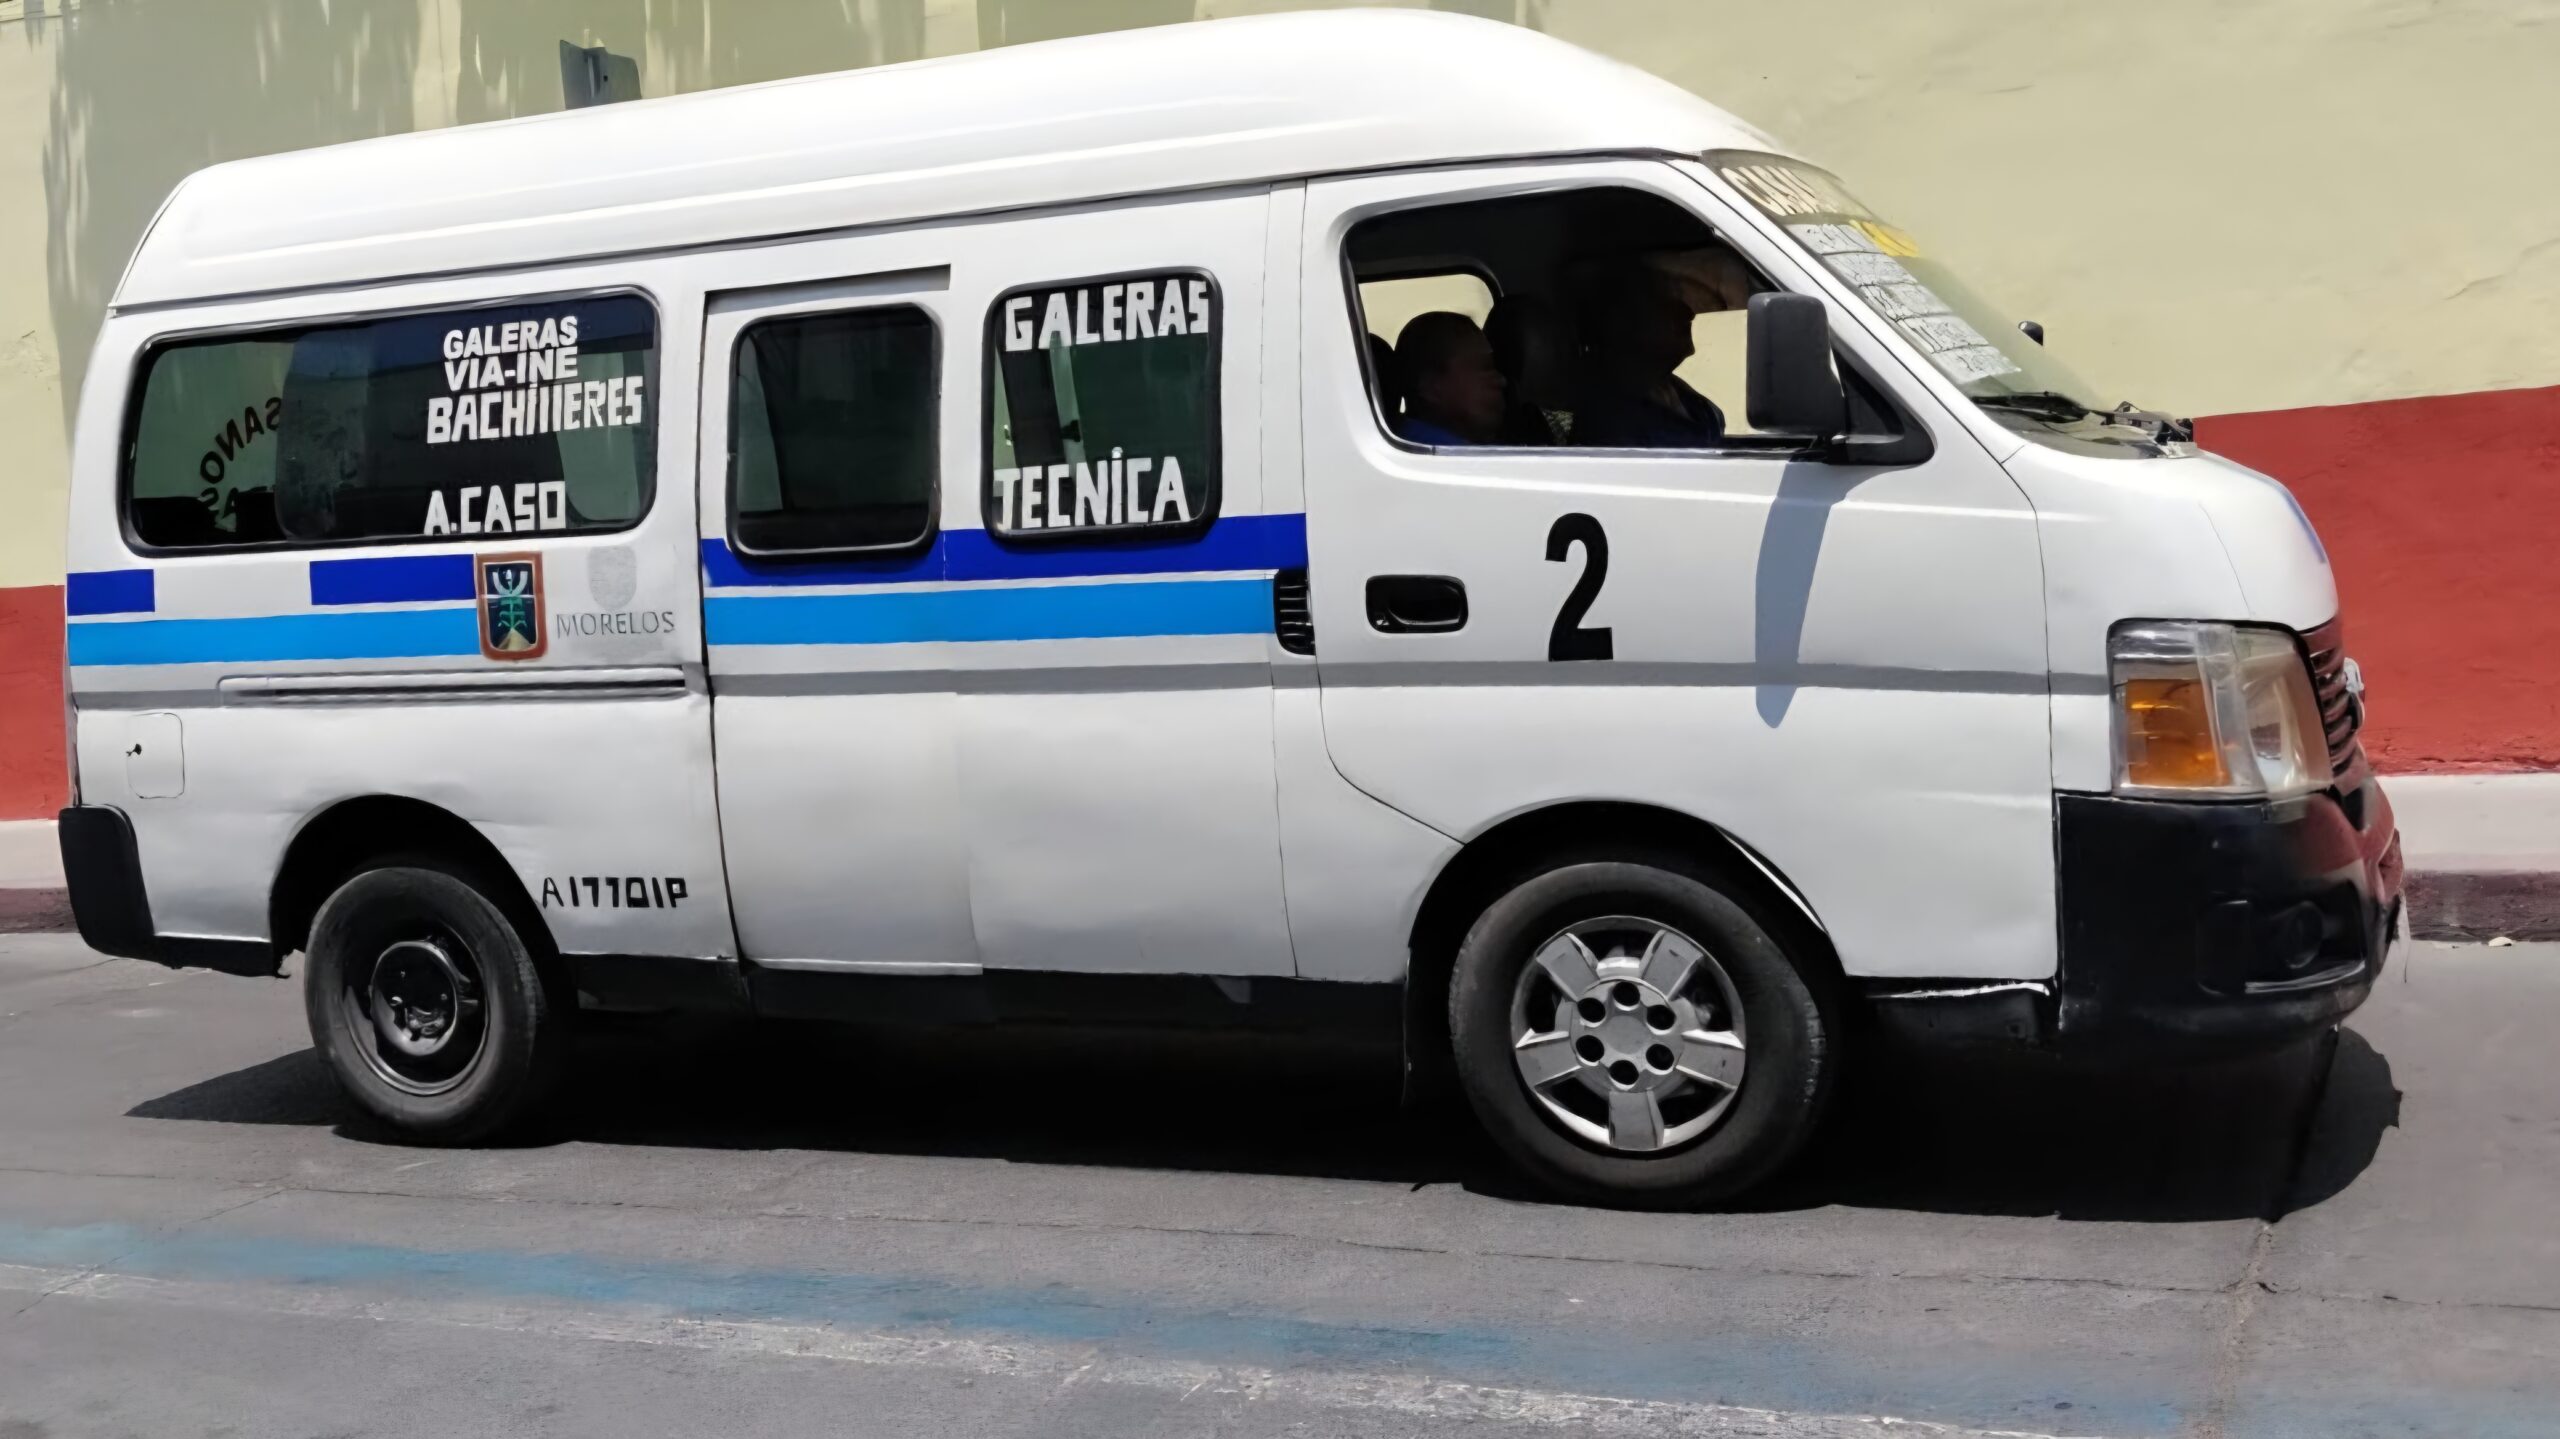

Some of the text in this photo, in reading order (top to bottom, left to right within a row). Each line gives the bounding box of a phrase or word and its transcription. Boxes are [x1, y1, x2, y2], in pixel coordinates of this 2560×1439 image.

[443, 315, 578, 360] GALERAS
[1005, 279, 1210, 352] GALERAS
[444, 346, 579, 391] VIA-INE
[424, 480, 567, 536] A.CASO
[1545, 512, 1614, 662] 2
[556, 611, 676, 639] MORELOS
[542, 876, 689, 908] A17701P
